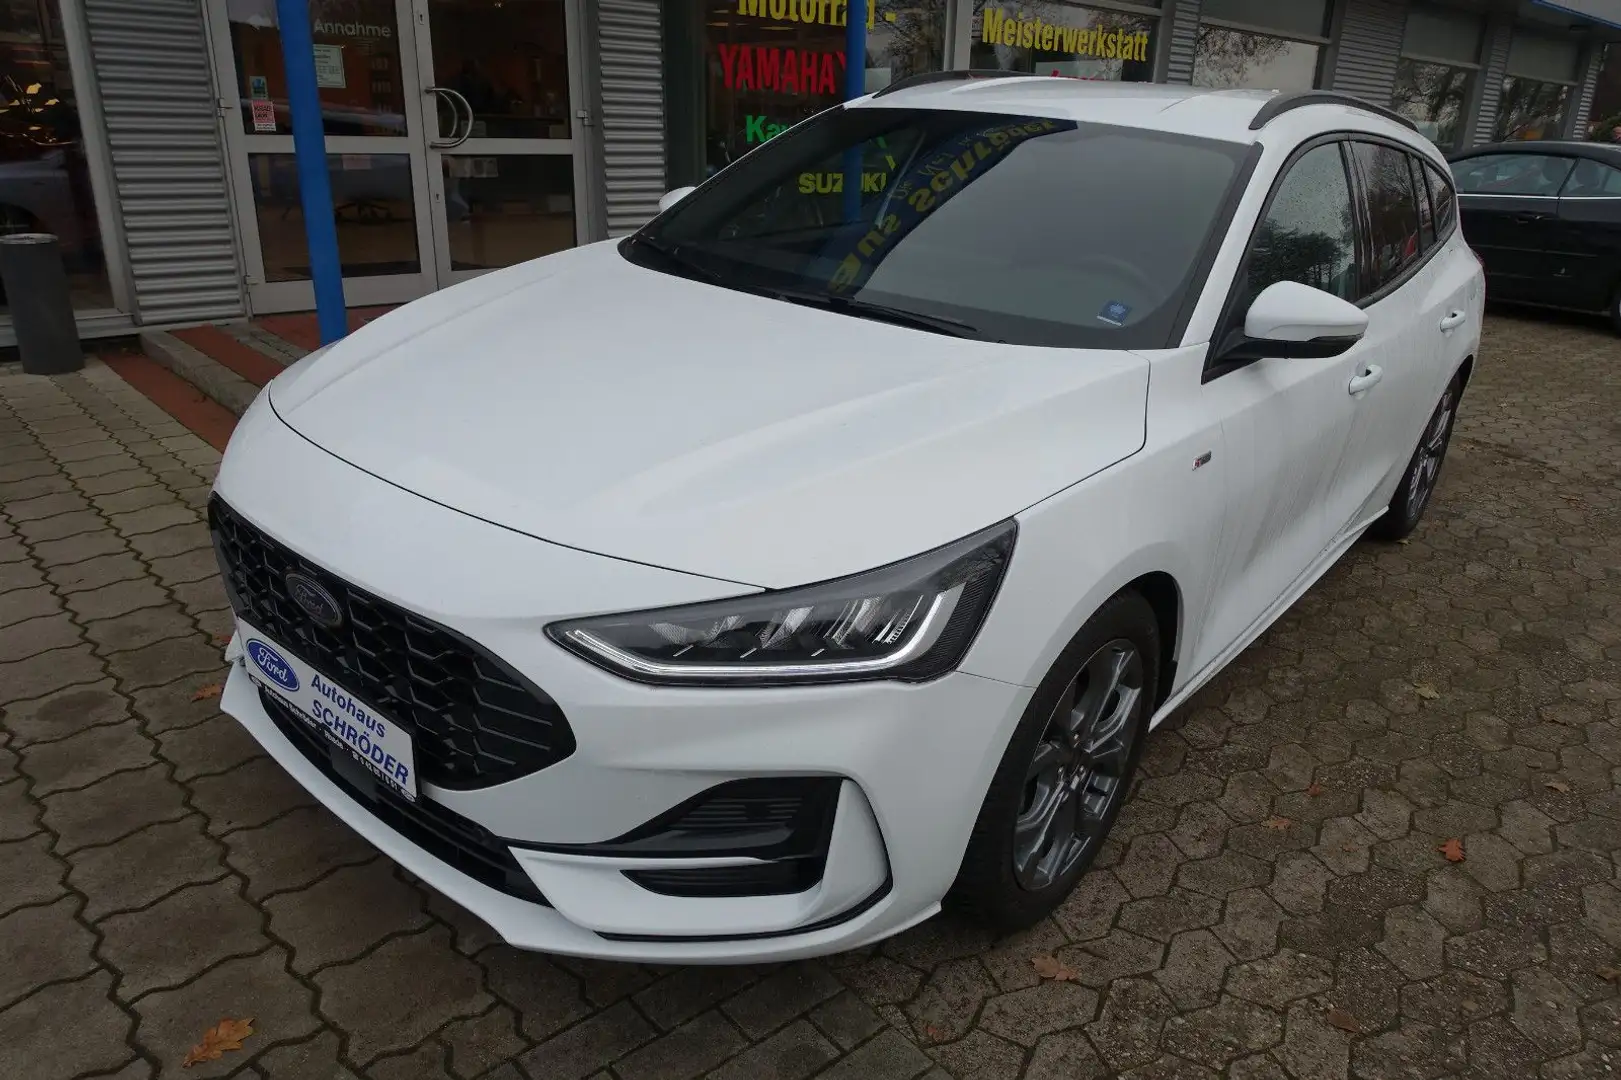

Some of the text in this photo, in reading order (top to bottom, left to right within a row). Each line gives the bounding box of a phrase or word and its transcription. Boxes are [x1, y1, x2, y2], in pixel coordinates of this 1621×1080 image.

[313, 17, 393, 39] Annahme
[982, 7, 1149, 62] Meisterwerkstatt
[717, 43, 836, 95] YAMAHA
[745, 115, 790, 144] Ka
[798, 172, 887, 195] SUZKI
[257, 646, 288, 682] Ford
[311, 673, 386, 738] Autohaus
[312, 699, 409, 785] SCHRÖDER
